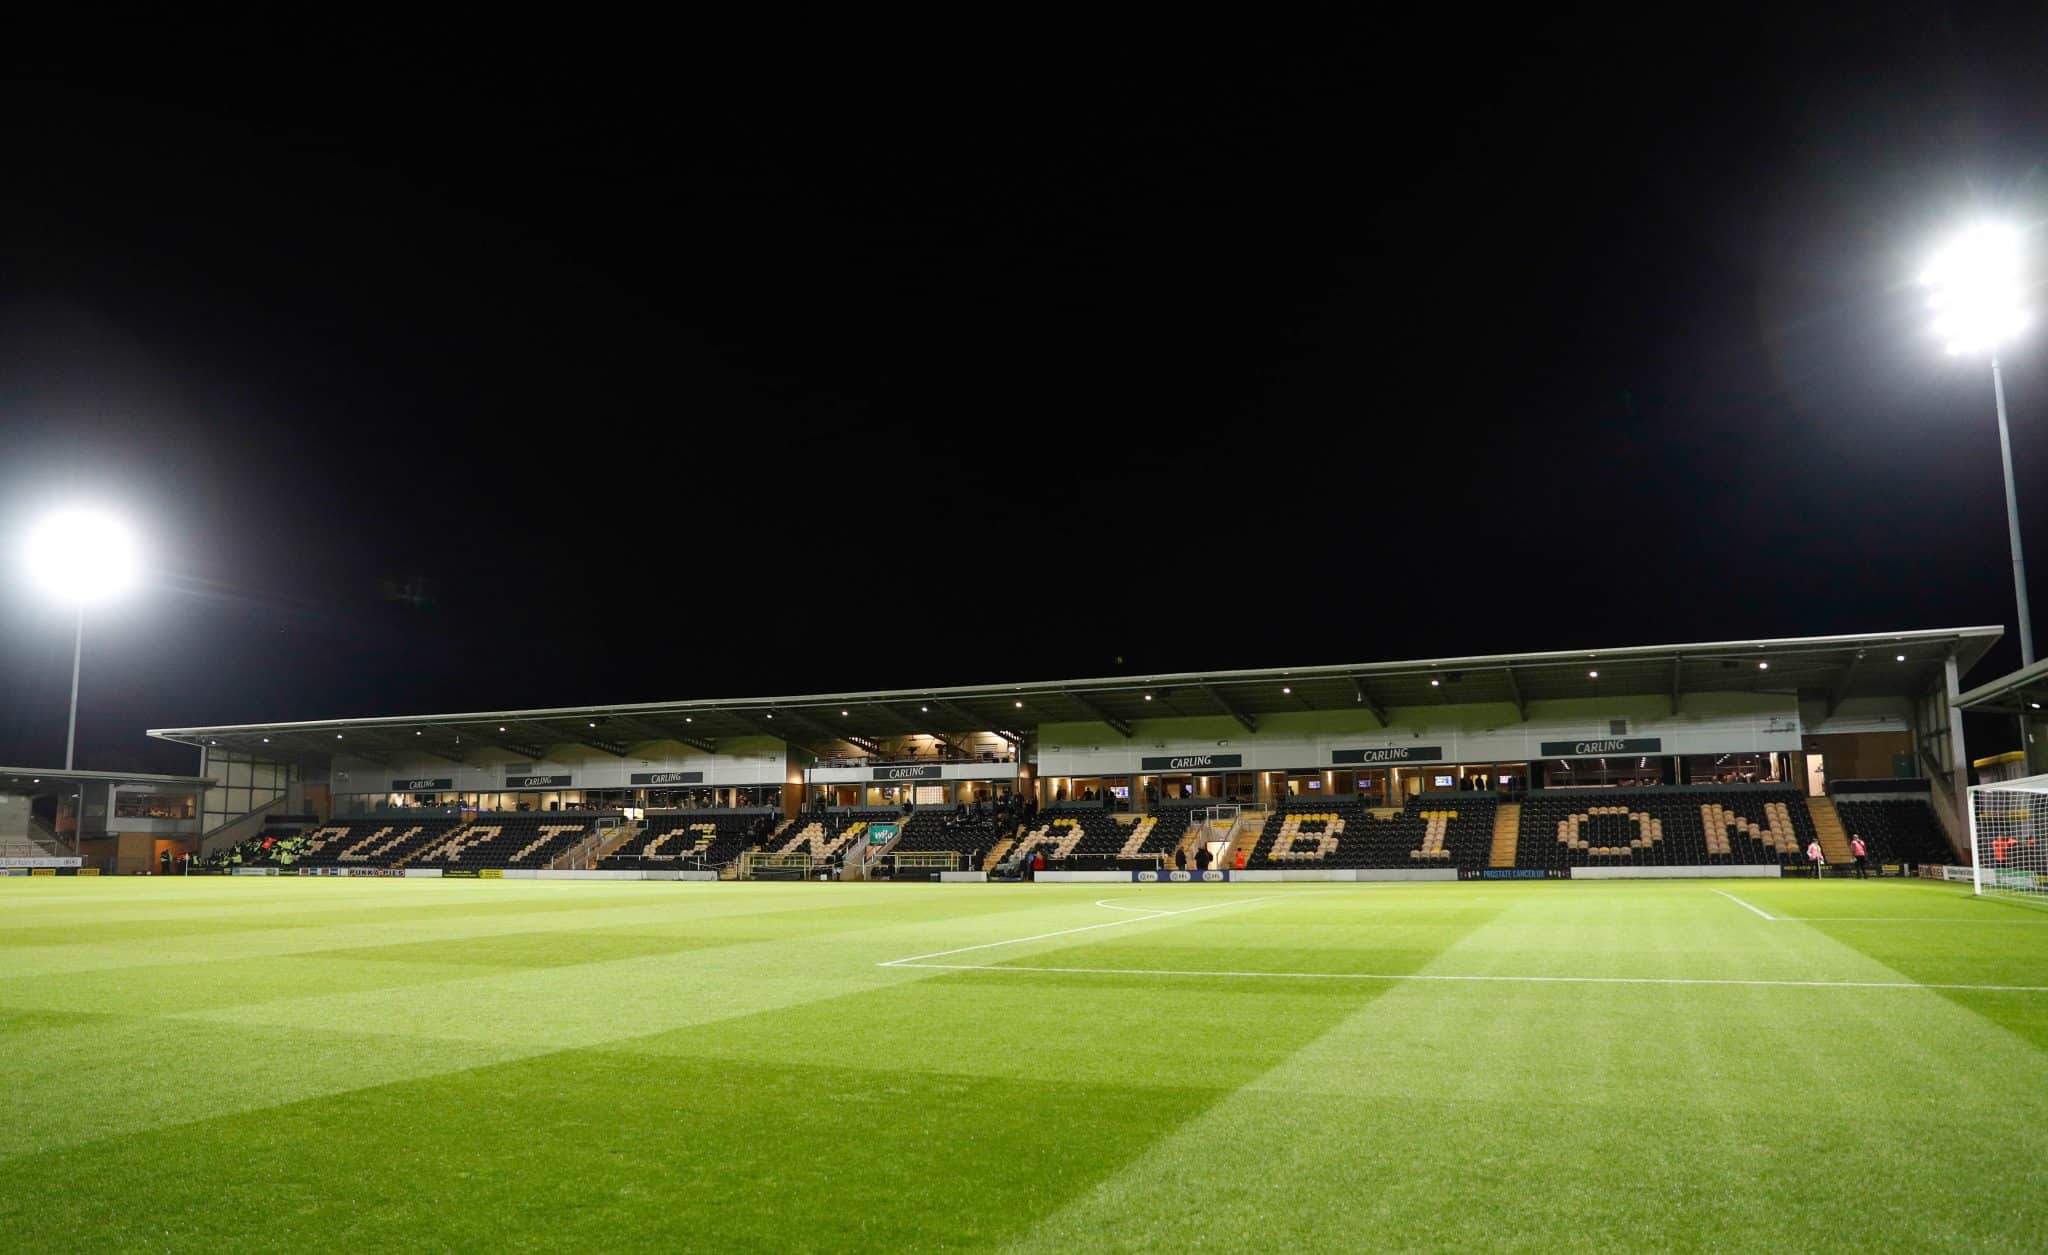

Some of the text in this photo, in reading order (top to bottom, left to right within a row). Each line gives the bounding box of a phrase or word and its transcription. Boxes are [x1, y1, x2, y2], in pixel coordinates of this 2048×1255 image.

[1575, 738, 1624, 755] CARLING
[1363, 747, 1408, 762] CARLING
[1170, 755, 1211, 769] CARLING
[651, 772, 681, 784] CARLING
[888, 766, 924, 779] CARLING
[409, 779, 434, 790] CARLING
[524, 776, 552, 787] CARLING
